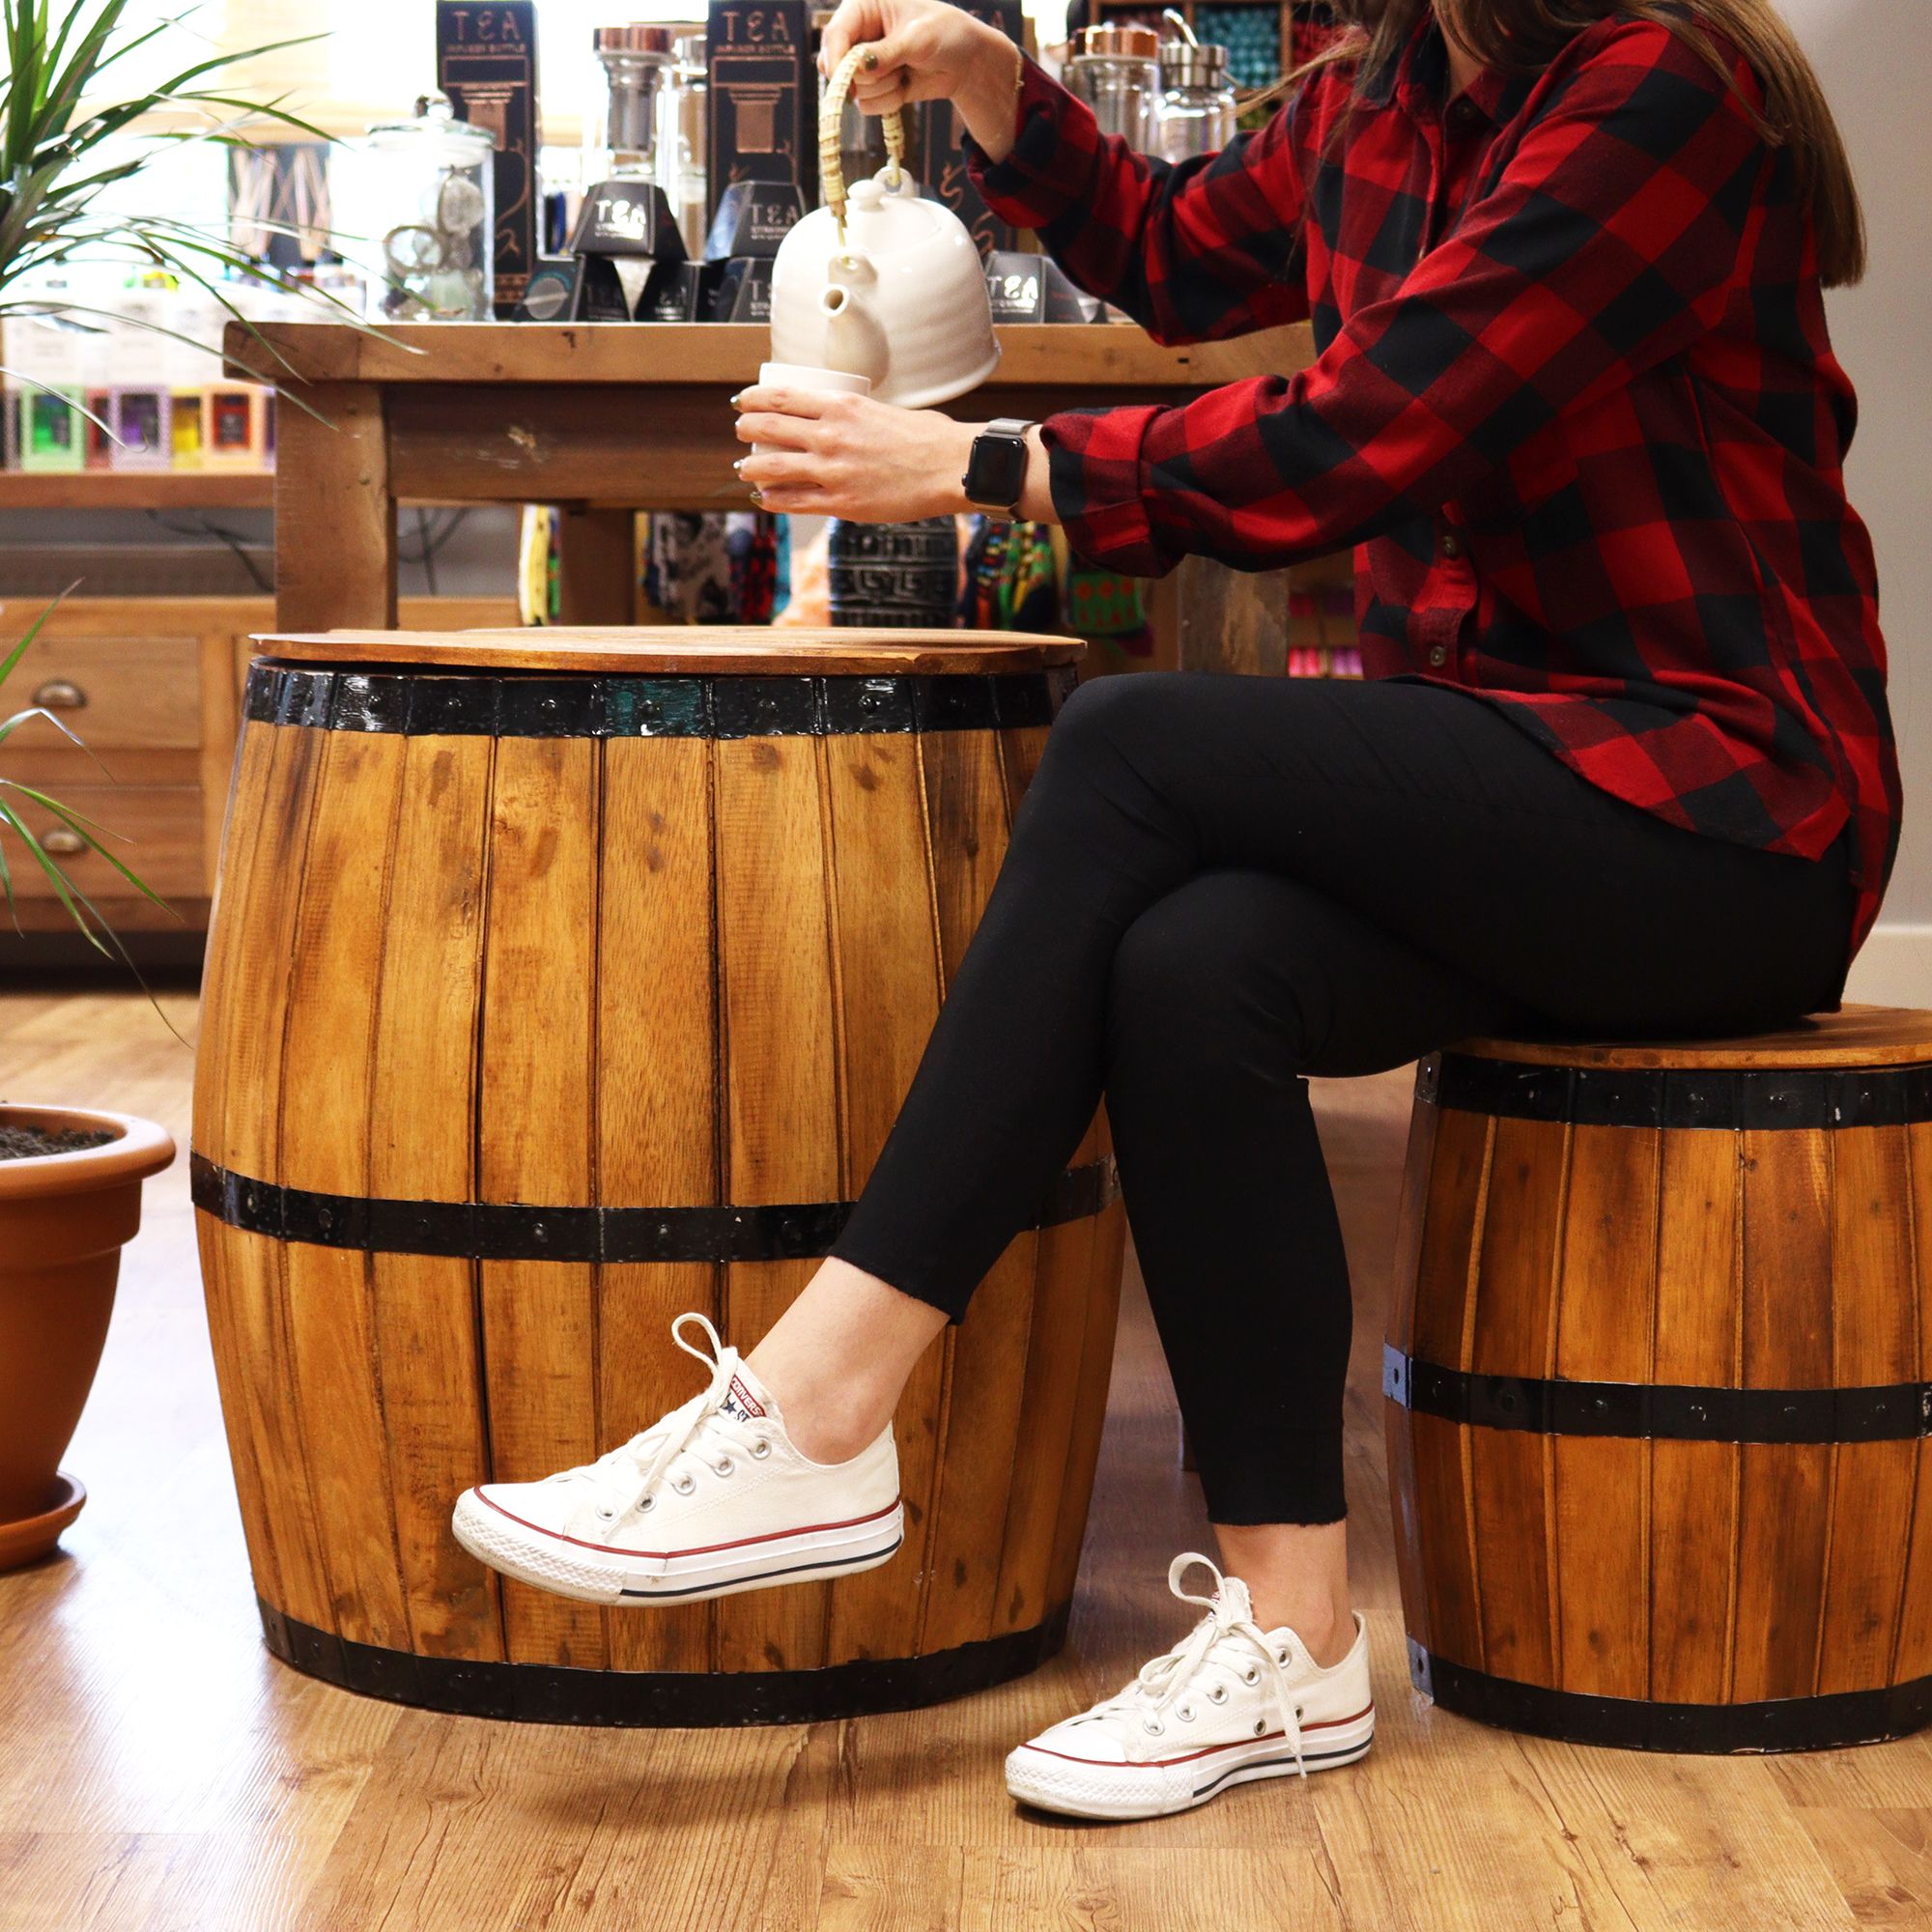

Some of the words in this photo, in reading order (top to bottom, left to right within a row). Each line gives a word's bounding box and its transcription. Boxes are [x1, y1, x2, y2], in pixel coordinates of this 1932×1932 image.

[452, 11, 521, 41] TEA
[722, 11, 789, 42] TEA
[595, 199, 646, 225] TEA
[749, 203, 801, 225] TEA
[987, 275, 1038, 300] TEA
